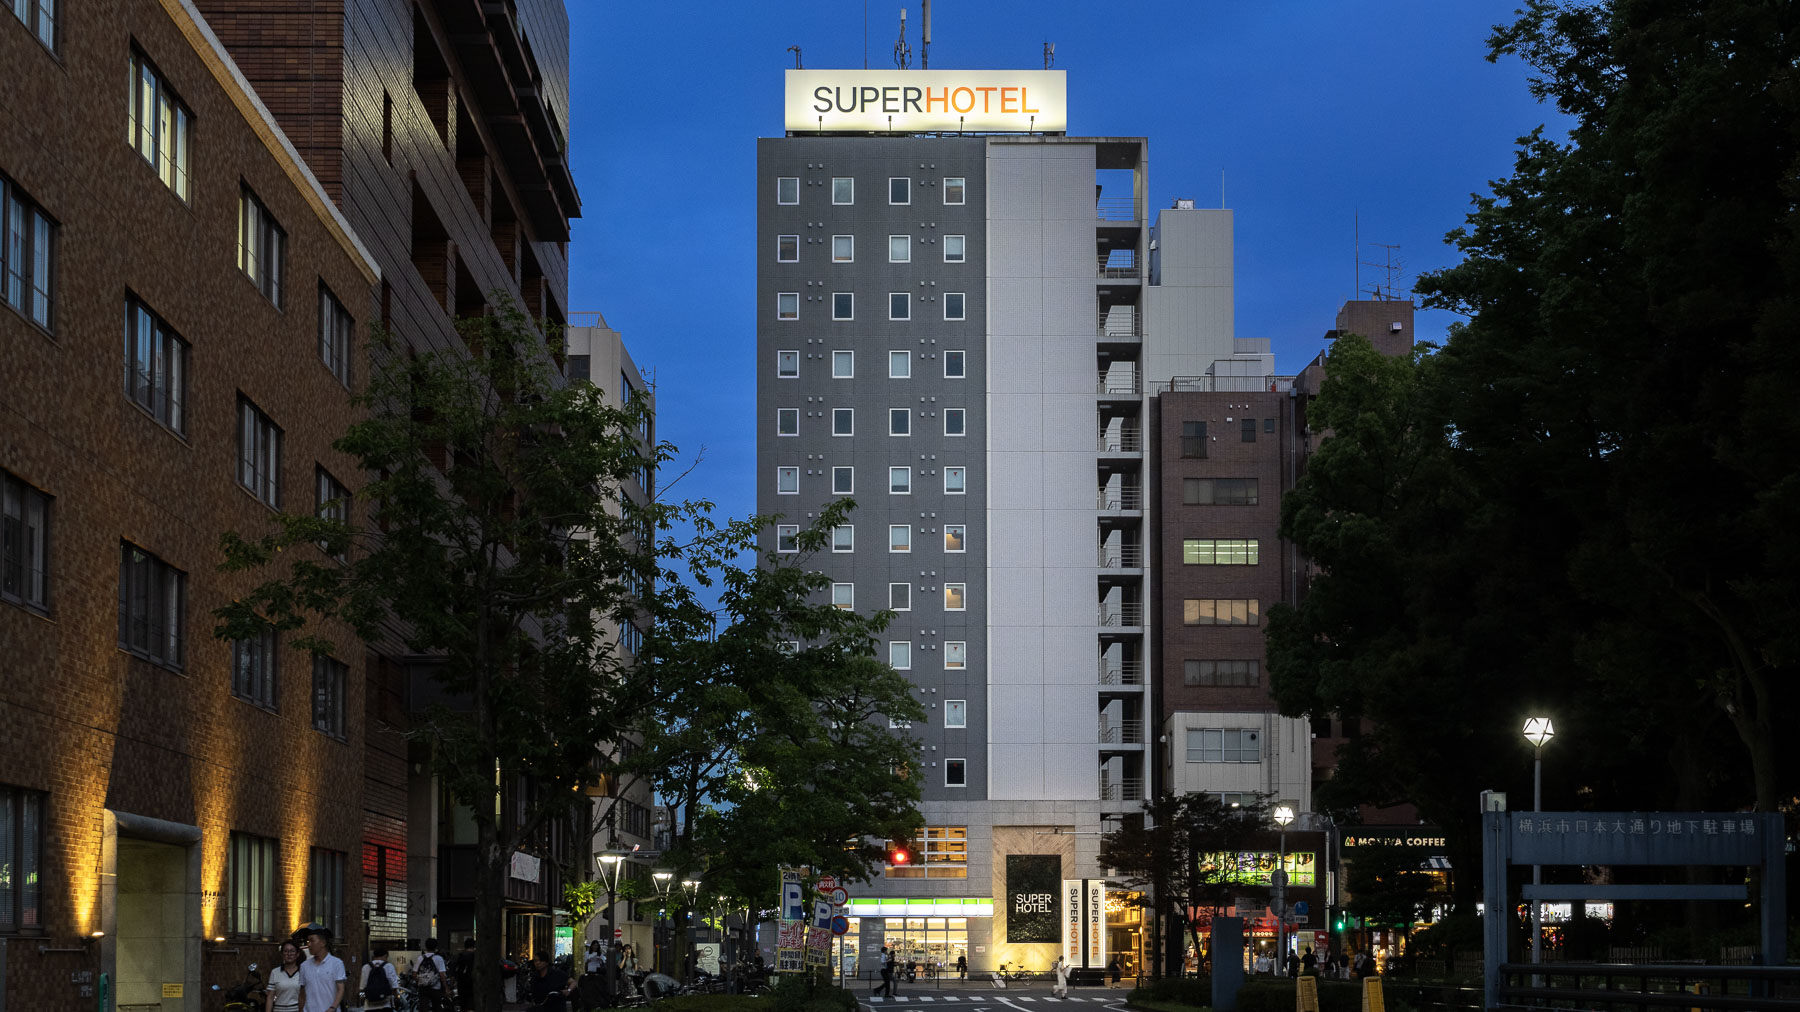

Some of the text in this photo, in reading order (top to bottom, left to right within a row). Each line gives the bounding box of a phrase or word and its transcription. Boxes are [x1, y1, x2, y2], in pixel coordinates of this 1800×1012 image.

[1519, 819, 1756, 835] 横浜市日本大通り地下駐車場
[1406, 837, 1446, 847] COFFEE
[784, 883, 802, 919] P
[1016, 893, 1052, 903] SUPER
[813, 901, 832, 928] P
[1016, 903, 1052, 913] HOTEL
